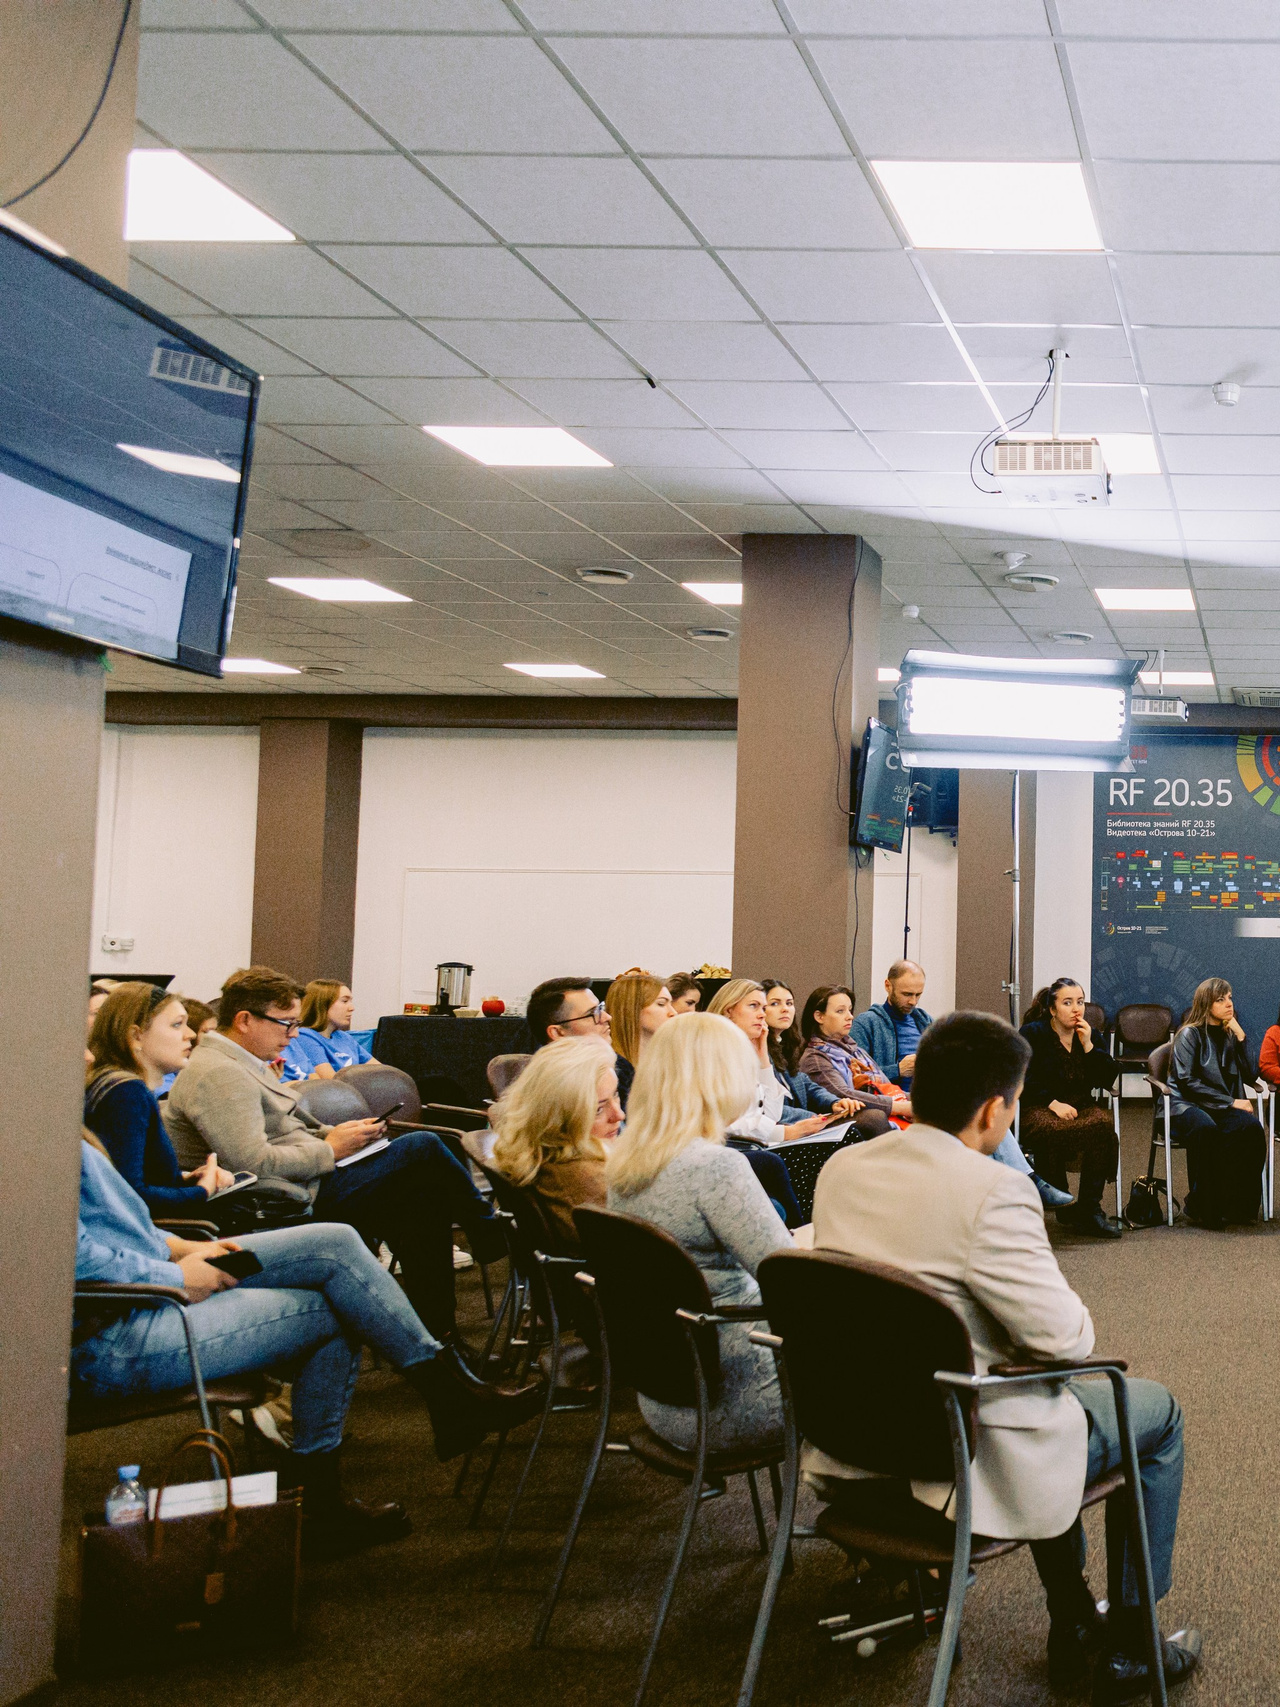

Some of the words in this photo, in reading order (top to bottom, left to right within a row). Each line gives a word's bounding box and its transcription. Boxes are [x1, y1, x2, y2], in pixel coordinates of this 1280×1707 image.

[1109, 778, 1146, 806] RF
[1153, 778, 1232, 806] 20.35
[1107, 819, 1150, 828] Библиотека
[1153, 819, 1179, 828] знаний
[1107, 829, 1147, 837] Видеотека
